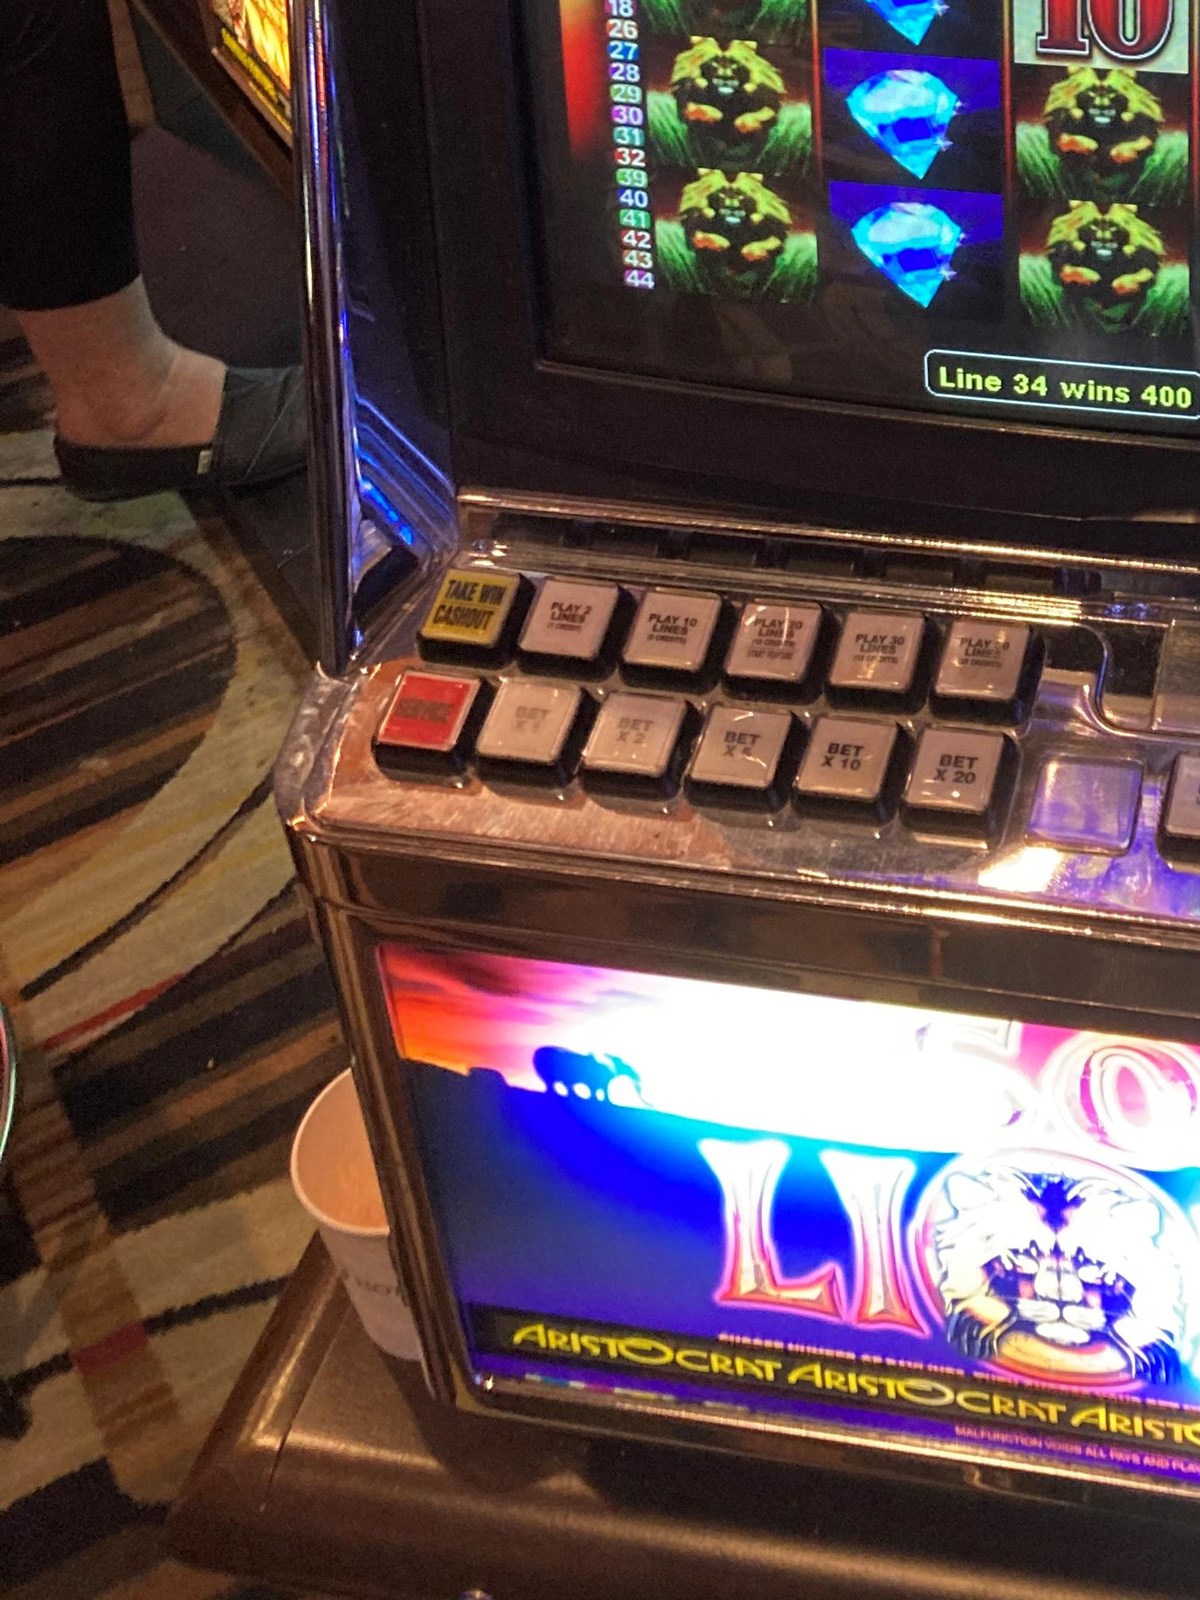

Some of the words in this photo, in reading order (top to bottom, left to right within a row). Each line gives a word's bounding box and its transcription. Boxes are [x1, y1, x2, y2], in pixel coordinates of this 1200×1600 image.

[609, 42, 639, 60] 27
[611, 63, 640, 82] 28
[617, 148, 646, 167] 32
[620, 189, 648, 208] 40
[623, 230, 651, 249] 42
[939, 366, 1002, 392] Line
[1013, 373, 1047, 397] 34
[1060, 380, 1130, 405] wins
[1141, 384, 1192, 409] 400
[448, 579, 479, 602] TAKE
[479, 584, 507, 606] WIN
[433, 604, 494, 631] CASHOUT
[551, 602, 583, 615] PLAY
[649, 613, 680, 624] PLAY
[684, 617, 698, 627] 10
[652, 623, 688, 635] LINES
[855, 634, 888, 644] PLAY
[827, 742, 864, 757] BET
[821, 755, 834, 767] X
[840, 758, 861, 771] 10
[939, 754, 978, 770] BET
[933, 768, 947, 781] X
[953, 771, 976, 784] 20
[513, 1323, 781, 1383] ARISTOCRAT
[788, 1362, 1066, 1424] ARISTOCRAT
